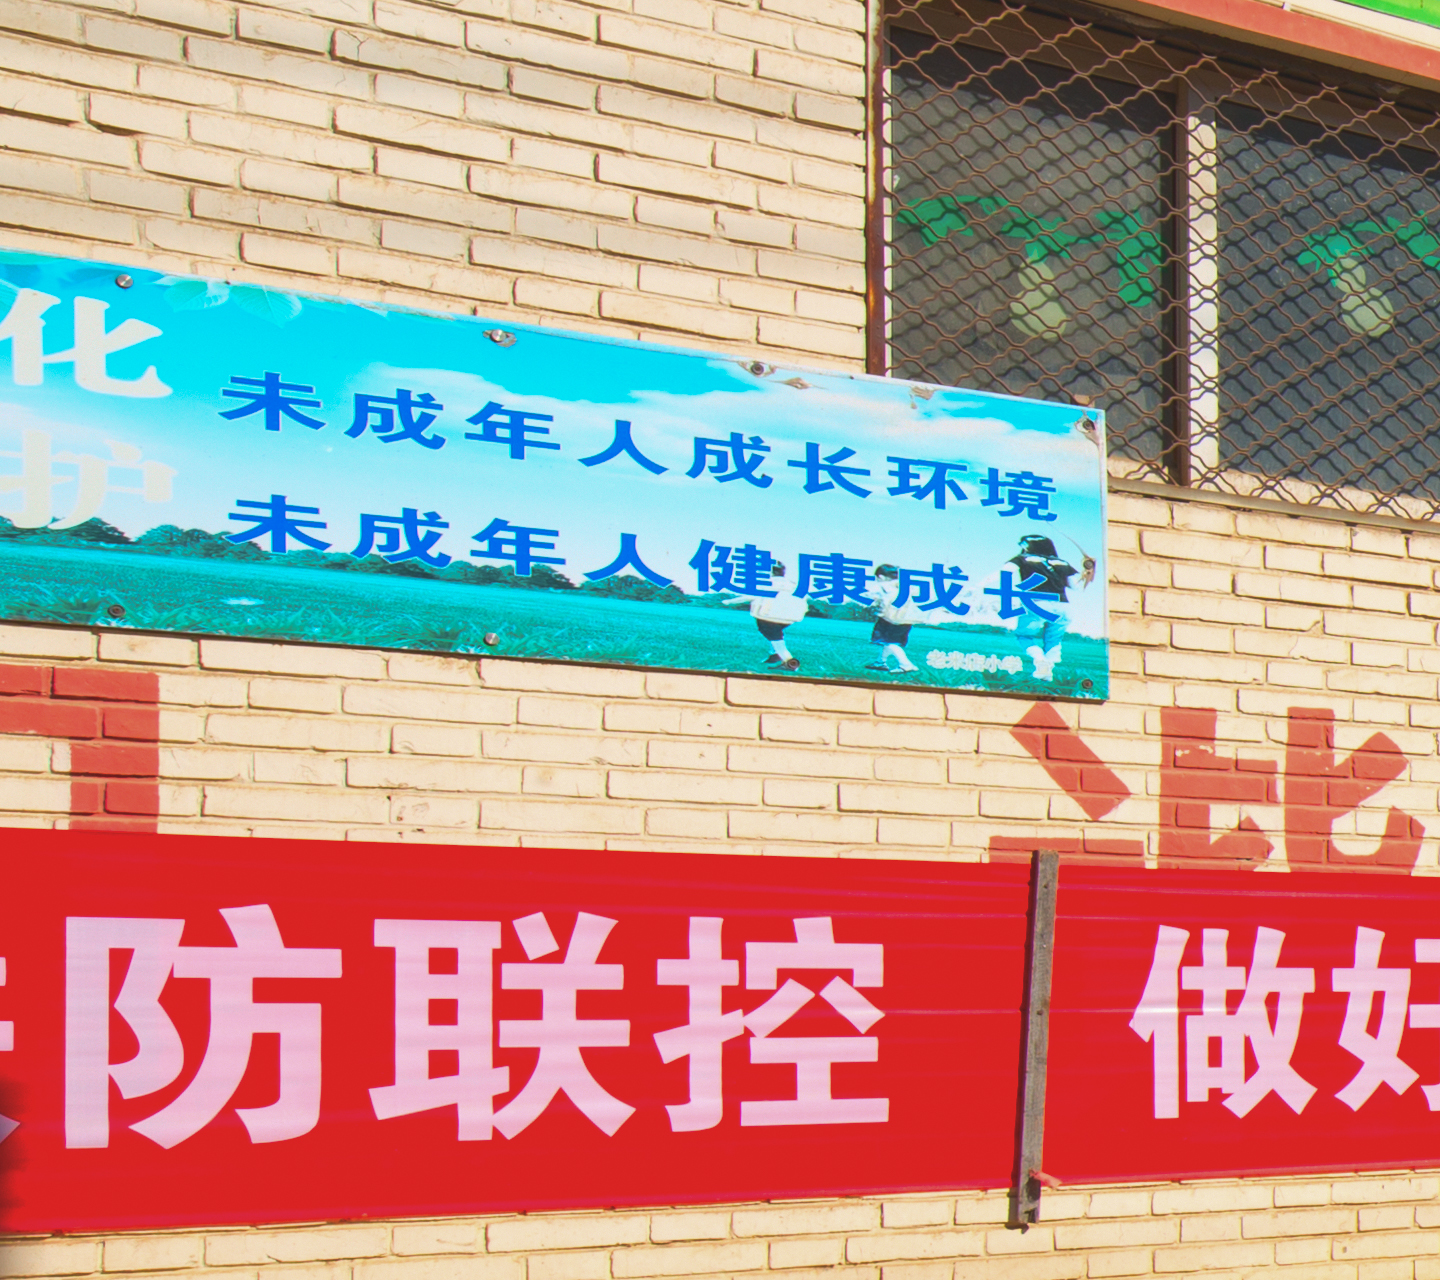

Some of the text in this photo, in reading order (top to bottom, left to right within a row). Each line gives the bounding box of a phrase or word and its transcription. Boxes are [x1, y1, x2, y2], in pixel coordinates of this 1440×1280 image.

[0, 287, 1060, 524] 化 未成年人成长环境
[227, 494, 1063, 625] 未成年人健康成长
[0, 905, 890, 1151] 防联控
